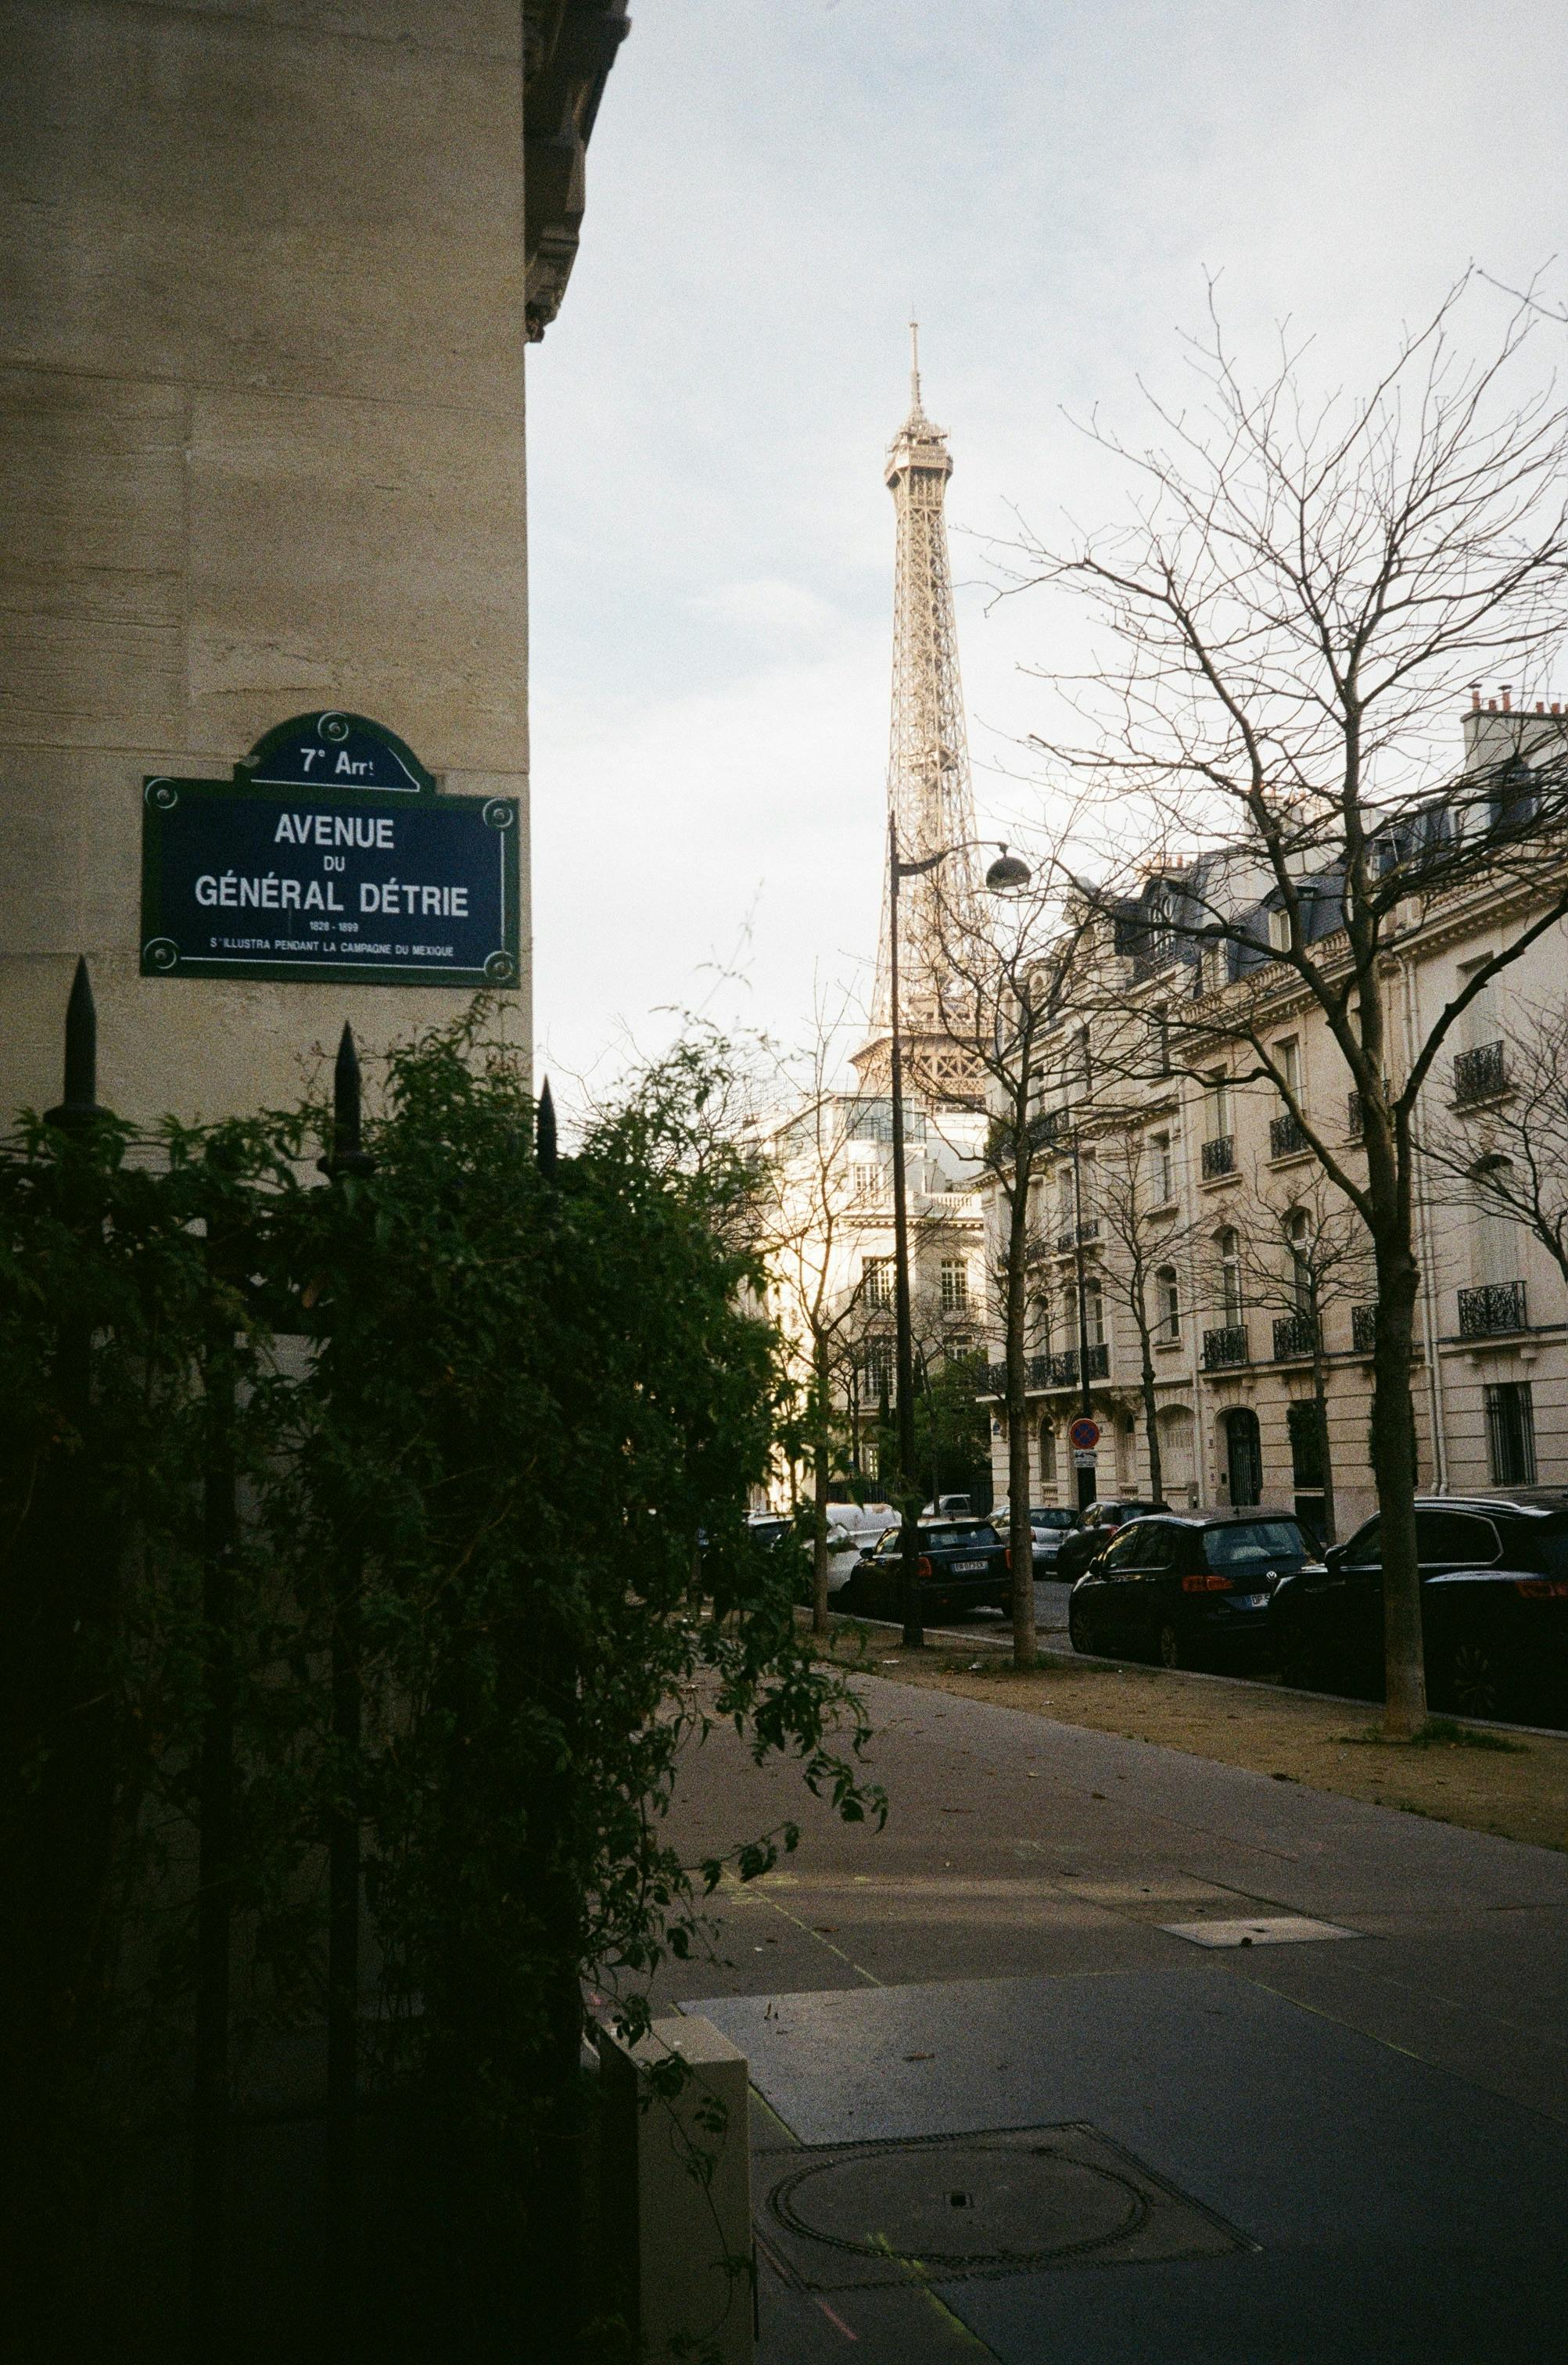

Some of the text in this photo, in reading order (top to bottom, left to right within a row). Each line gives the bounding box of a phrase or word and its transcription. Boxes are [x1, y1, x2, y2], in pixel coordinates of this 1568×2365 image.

[274, 813, 394, 849] AVENUE
[324, 856, 346, 872] DU
[196, 870, 468, 917] GÉNÉRAL DÉTRIE
[275, 940, 319, 951] PENDANT
[323, 942, 336, 952] LA
[341, 942, 392, 954] CAMPAGNE
[396, 945, 409, 955] DU
[413, 946, 454, 956] MEXIQUE
